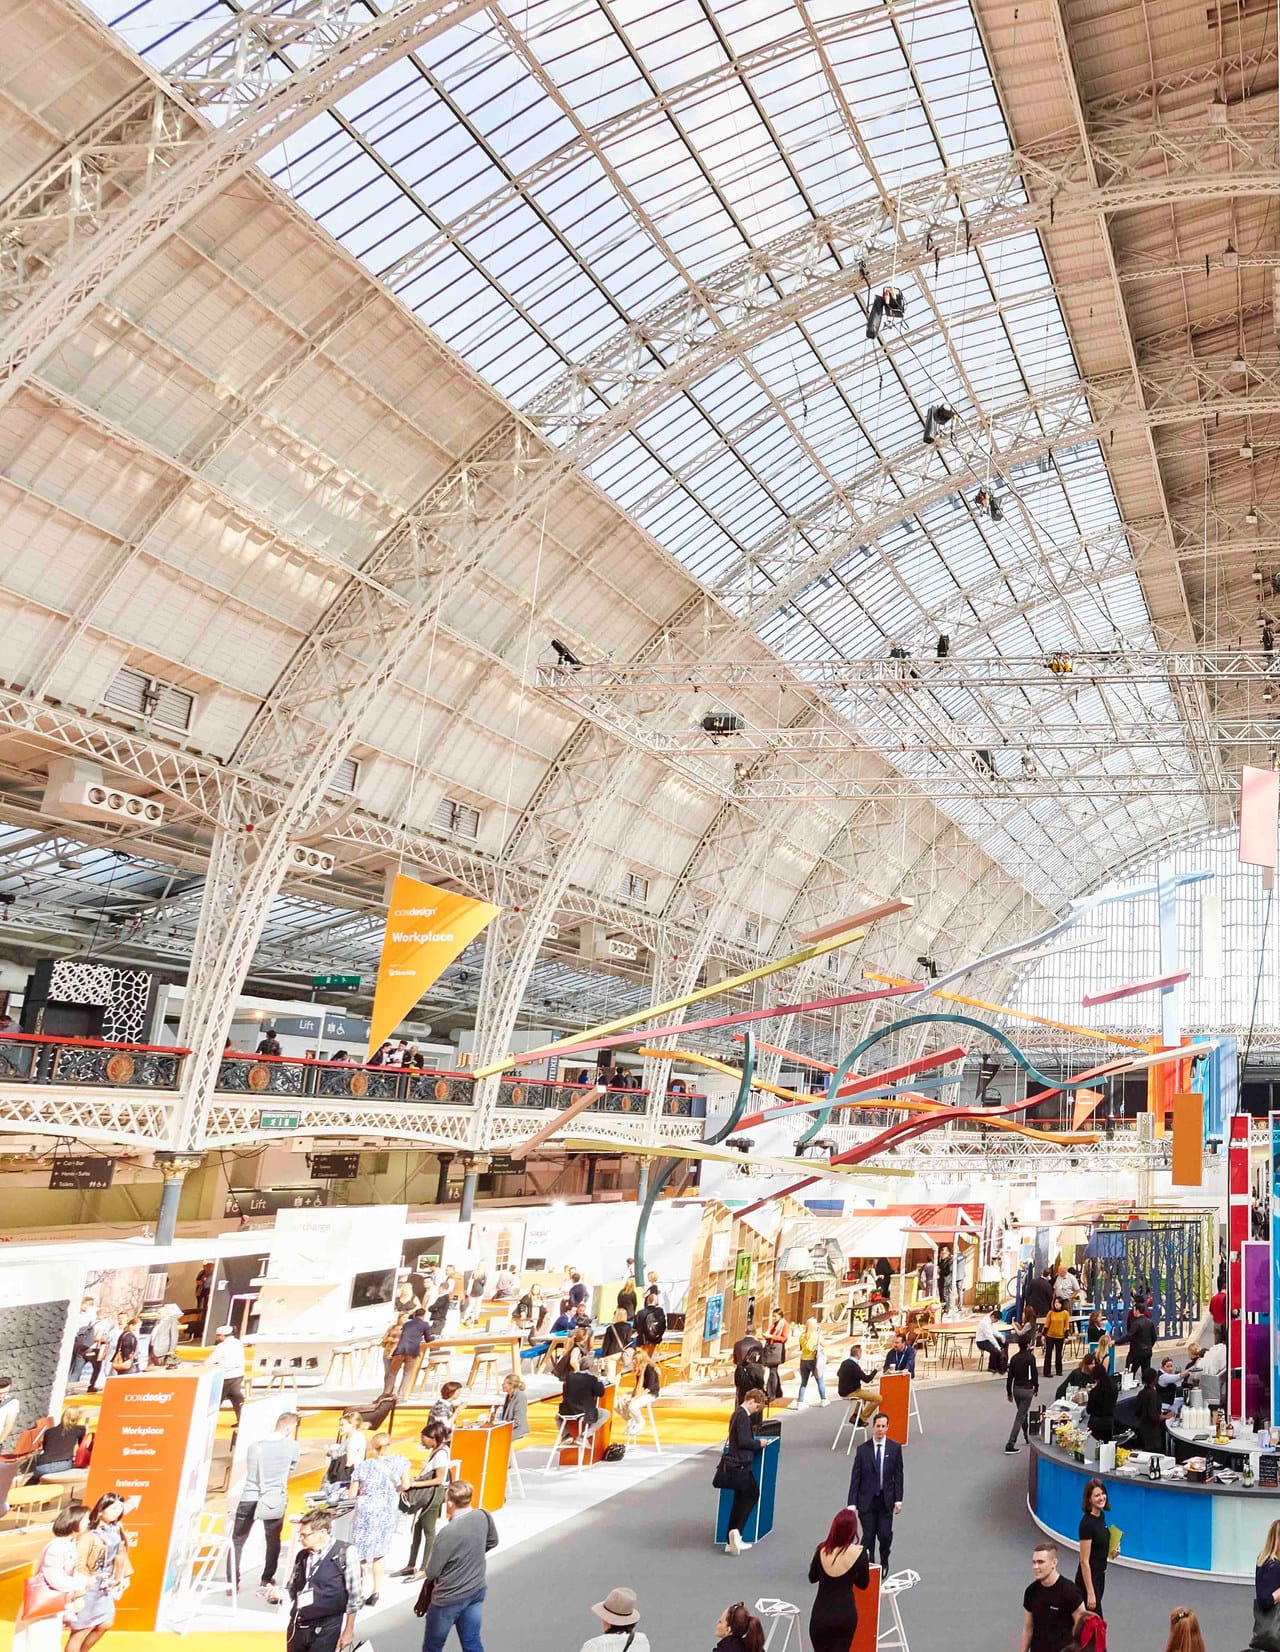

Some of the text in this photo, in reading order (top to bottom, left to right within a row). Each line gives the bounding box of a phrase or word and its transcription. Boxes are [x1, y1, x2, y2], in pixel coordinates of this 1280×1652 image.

[392, 931, 454, 944] Workplace
[299, 1020, 314, 1030] Lift
[250, 1200, 266, 1210] Lift
[122, 1426, 164, 1437] Workplace
[115, 1479, 150, 1488] Interiors
